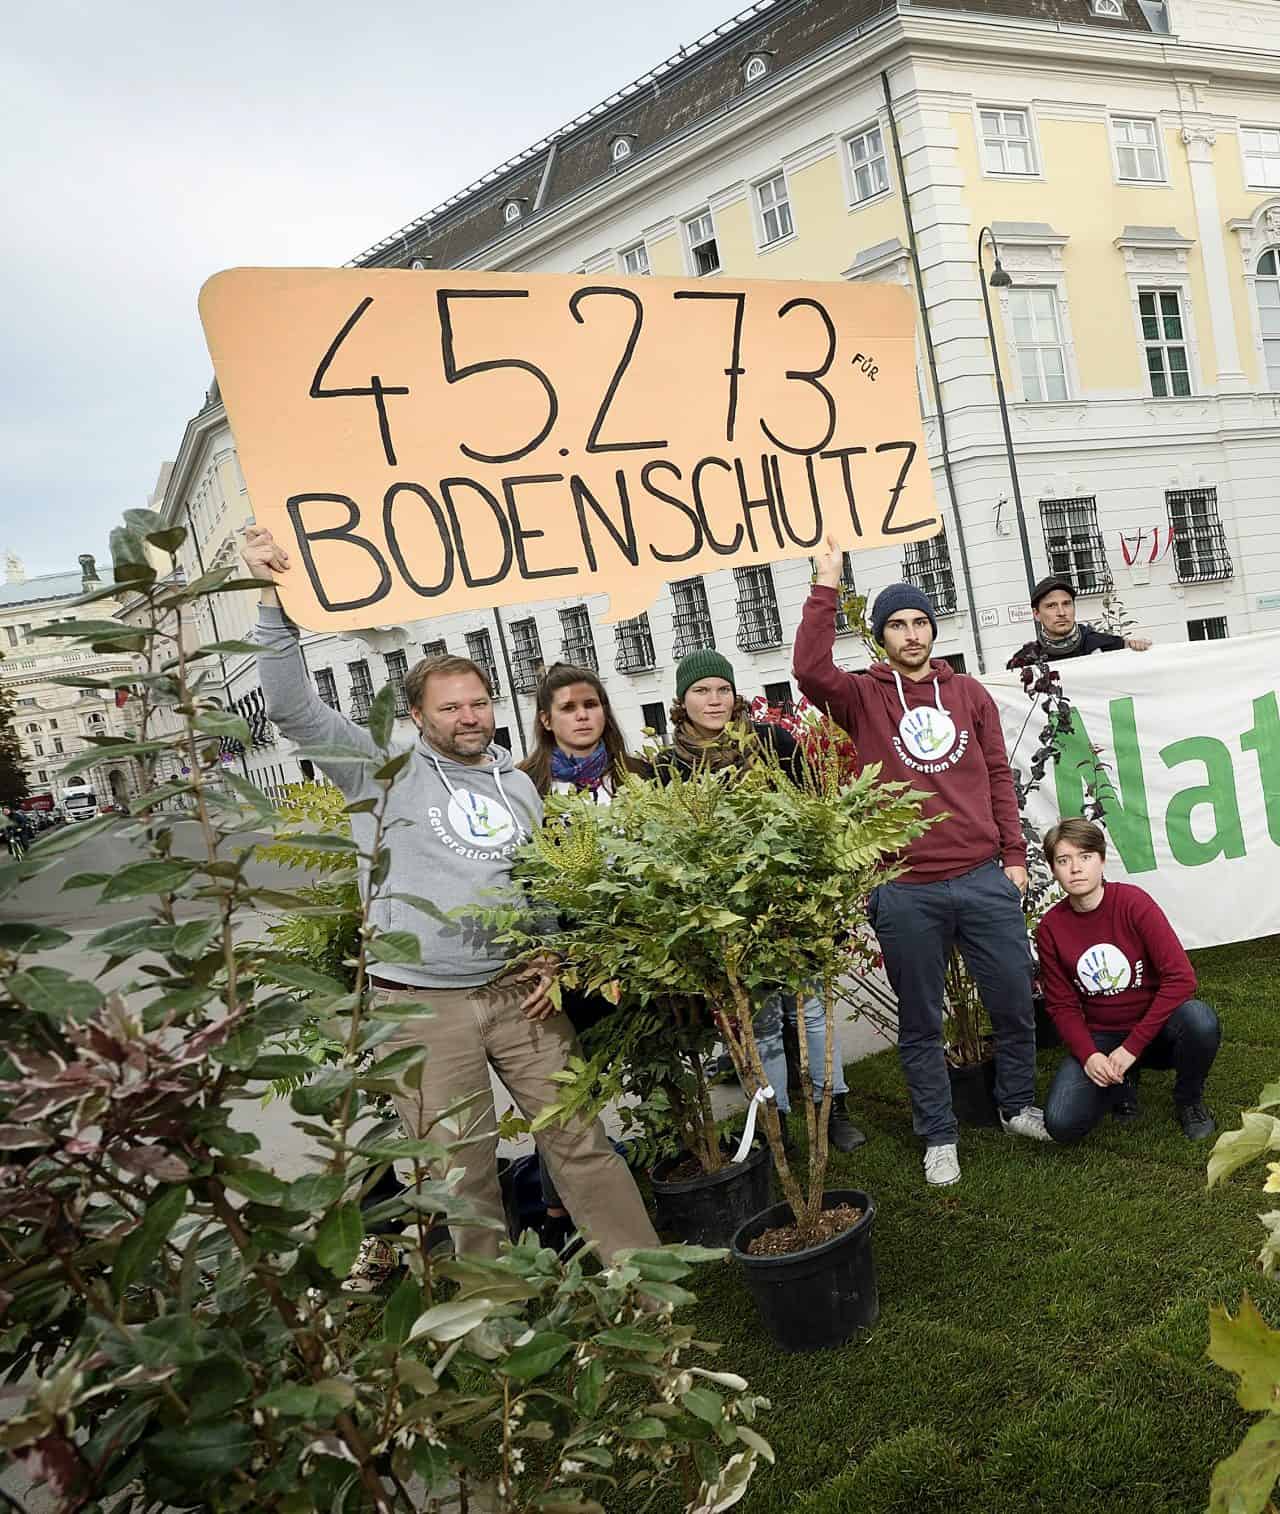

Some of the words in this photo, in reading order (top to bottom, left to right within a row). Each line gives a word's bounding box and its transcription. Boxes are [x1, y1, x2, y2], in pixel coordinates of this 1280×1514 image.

[851, 353, 879, 382] FÜR
[286, 441, 937, 613] BODENSCHUTZ
[948, 729, 969, 764] Earth
[427, 806, 502, 861] Generation
